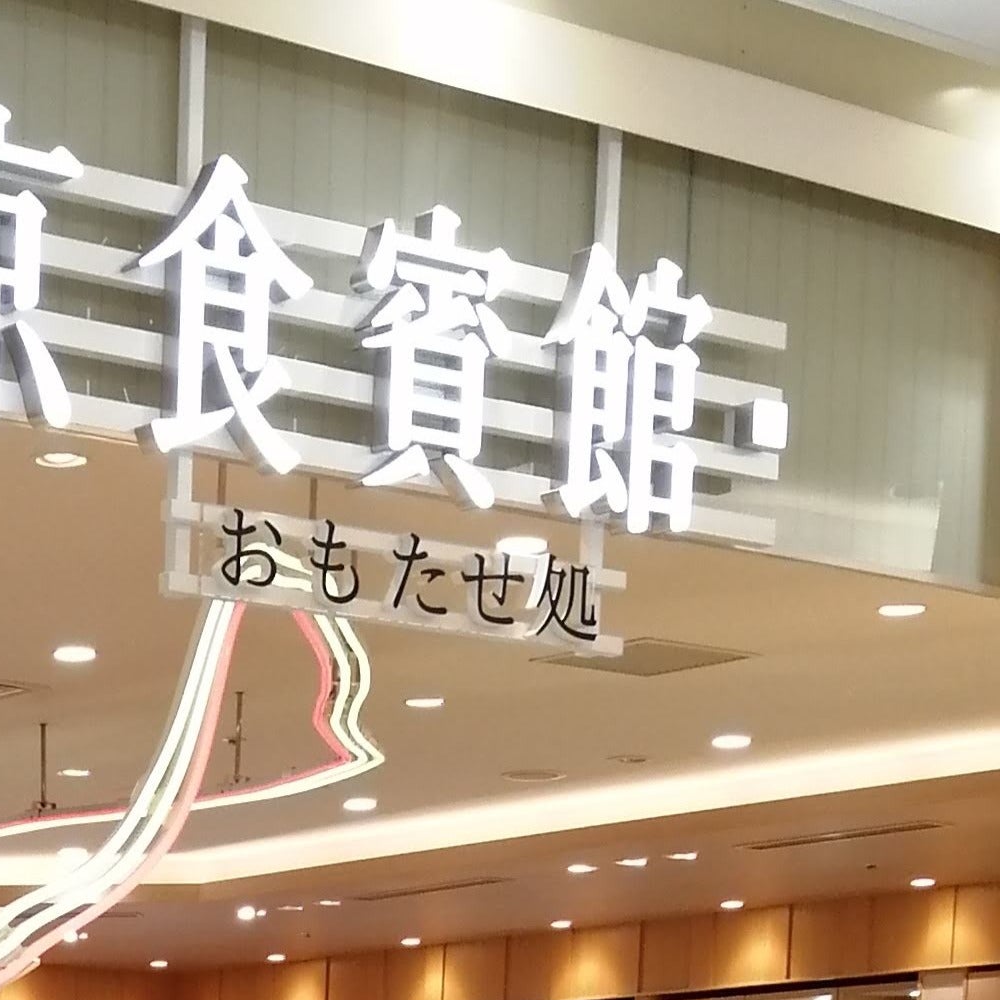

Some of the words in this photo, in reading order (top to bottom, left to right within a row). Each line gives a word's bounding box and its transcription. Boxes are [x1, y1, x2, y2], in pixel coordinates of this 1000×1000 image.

[220, 508, 599, 642] おもたせ処
